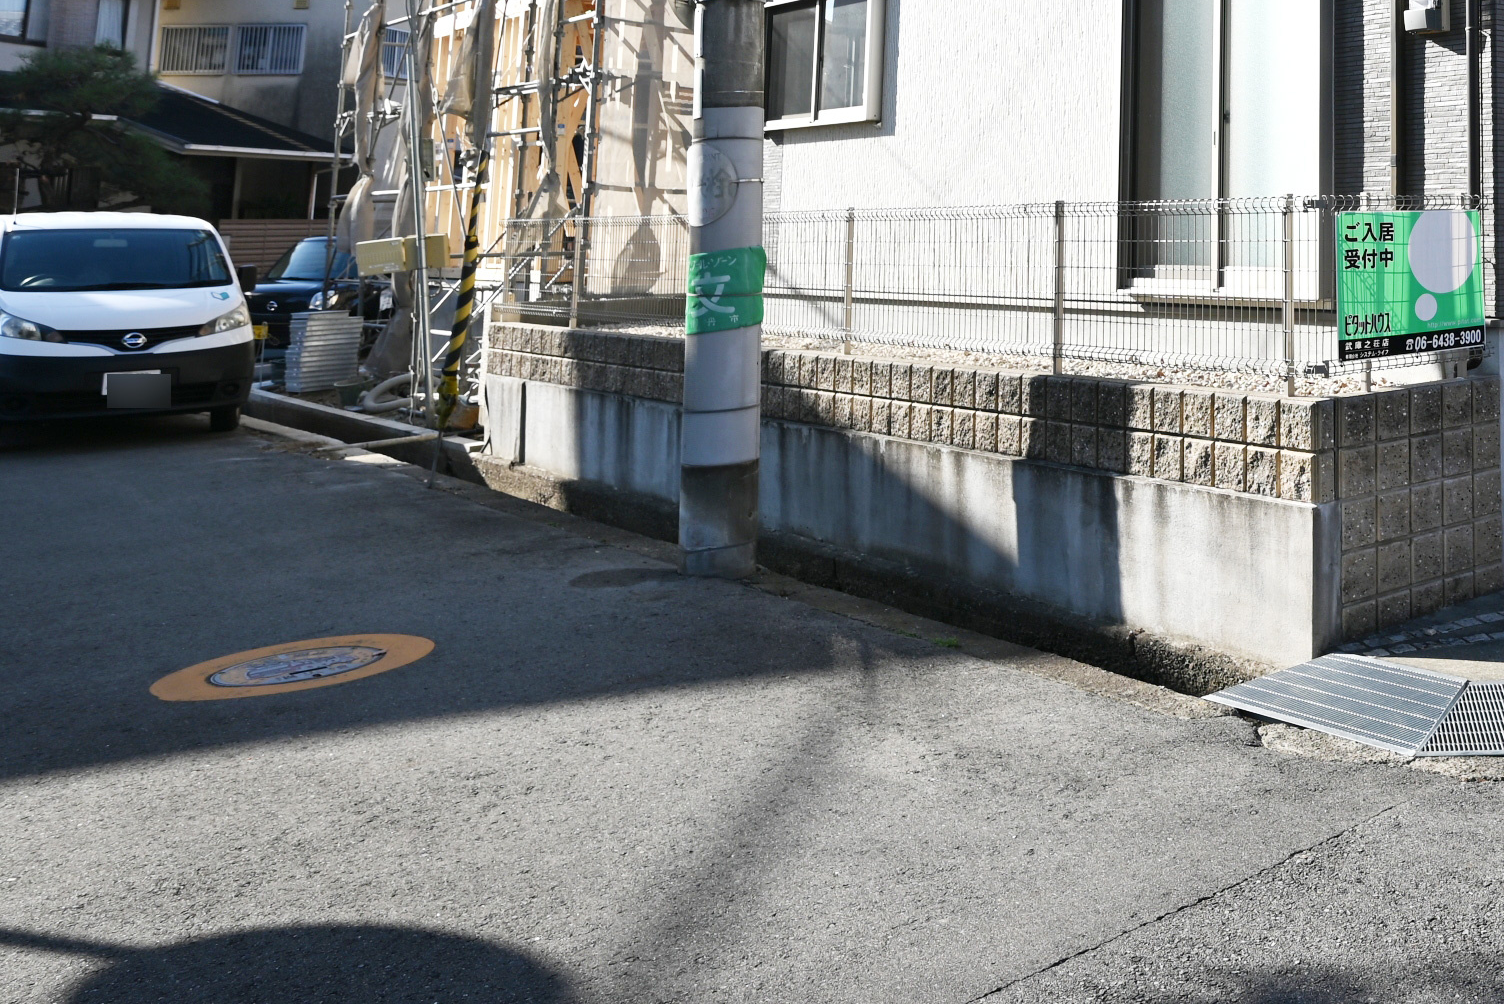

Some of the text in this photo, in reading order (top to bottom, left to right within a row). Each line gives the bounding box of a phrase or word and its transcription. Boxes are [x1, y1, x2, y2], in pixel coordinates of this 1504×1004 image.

[1344, 222, 1395, 243] ご入居
[1344, 248, 1394, 270] 受付中
[1345, 312, 1391, 336] ピタットハウス
[1345, 338, 1390, 350] 武庫之荘店
[1415, 329, 1481, 350] 06-6438-3900
